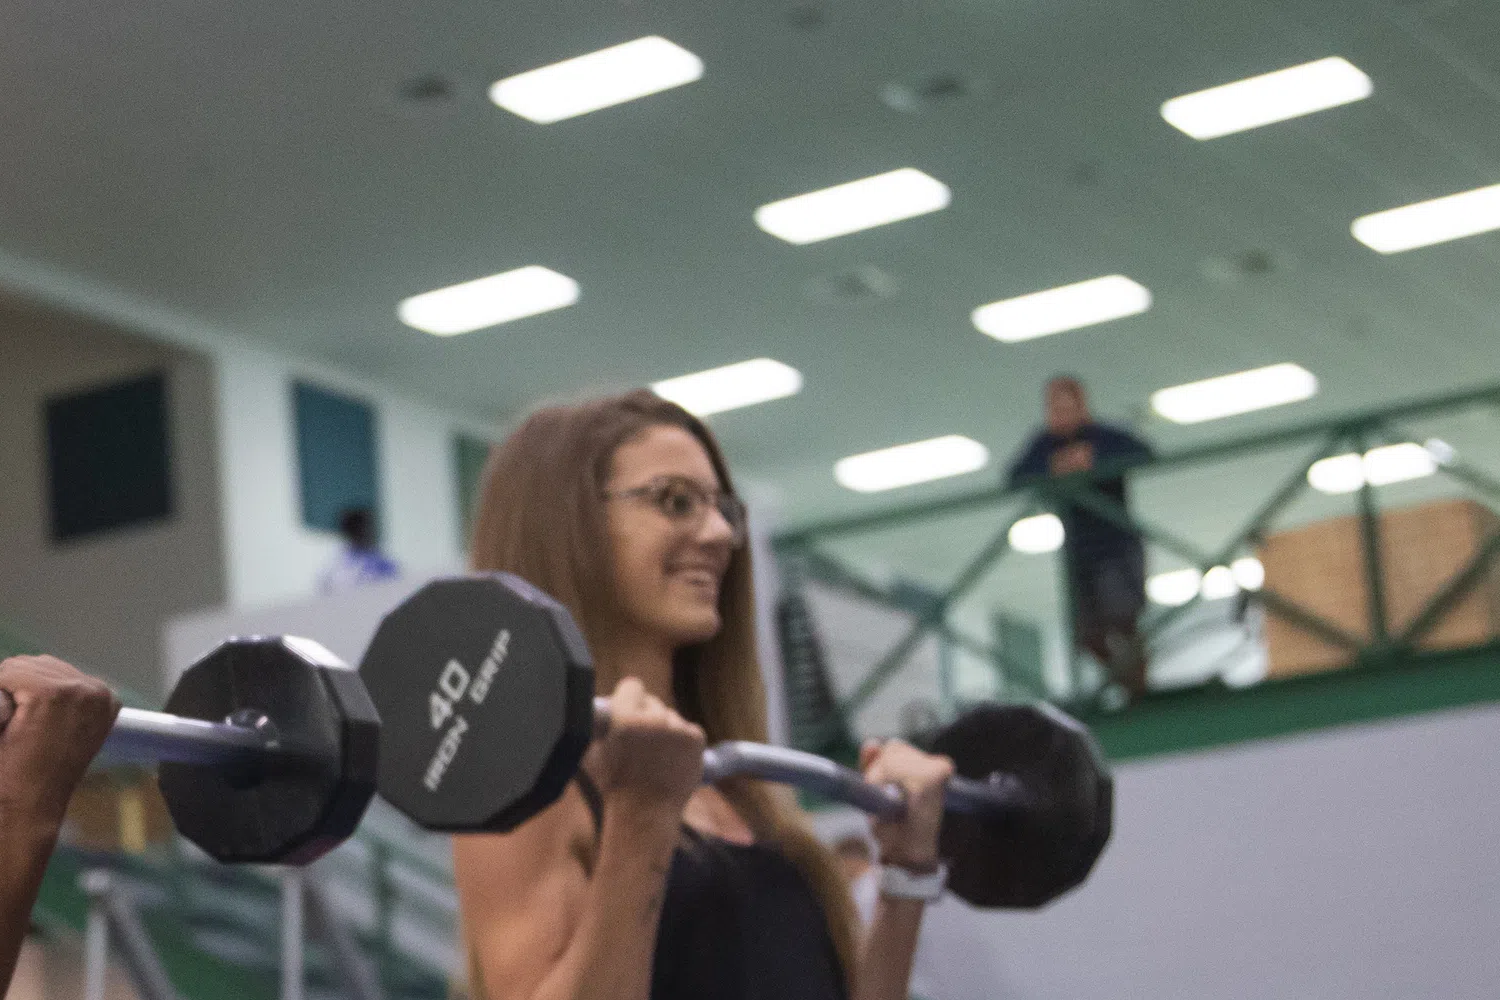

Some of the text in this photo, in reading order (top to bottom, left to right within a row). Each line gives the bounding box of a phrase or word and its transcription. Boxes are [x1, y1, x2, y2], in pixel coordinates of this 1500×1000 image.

[423, 628, 512, 791] IRON GRIP
[428, 658, 471, 730] 40
